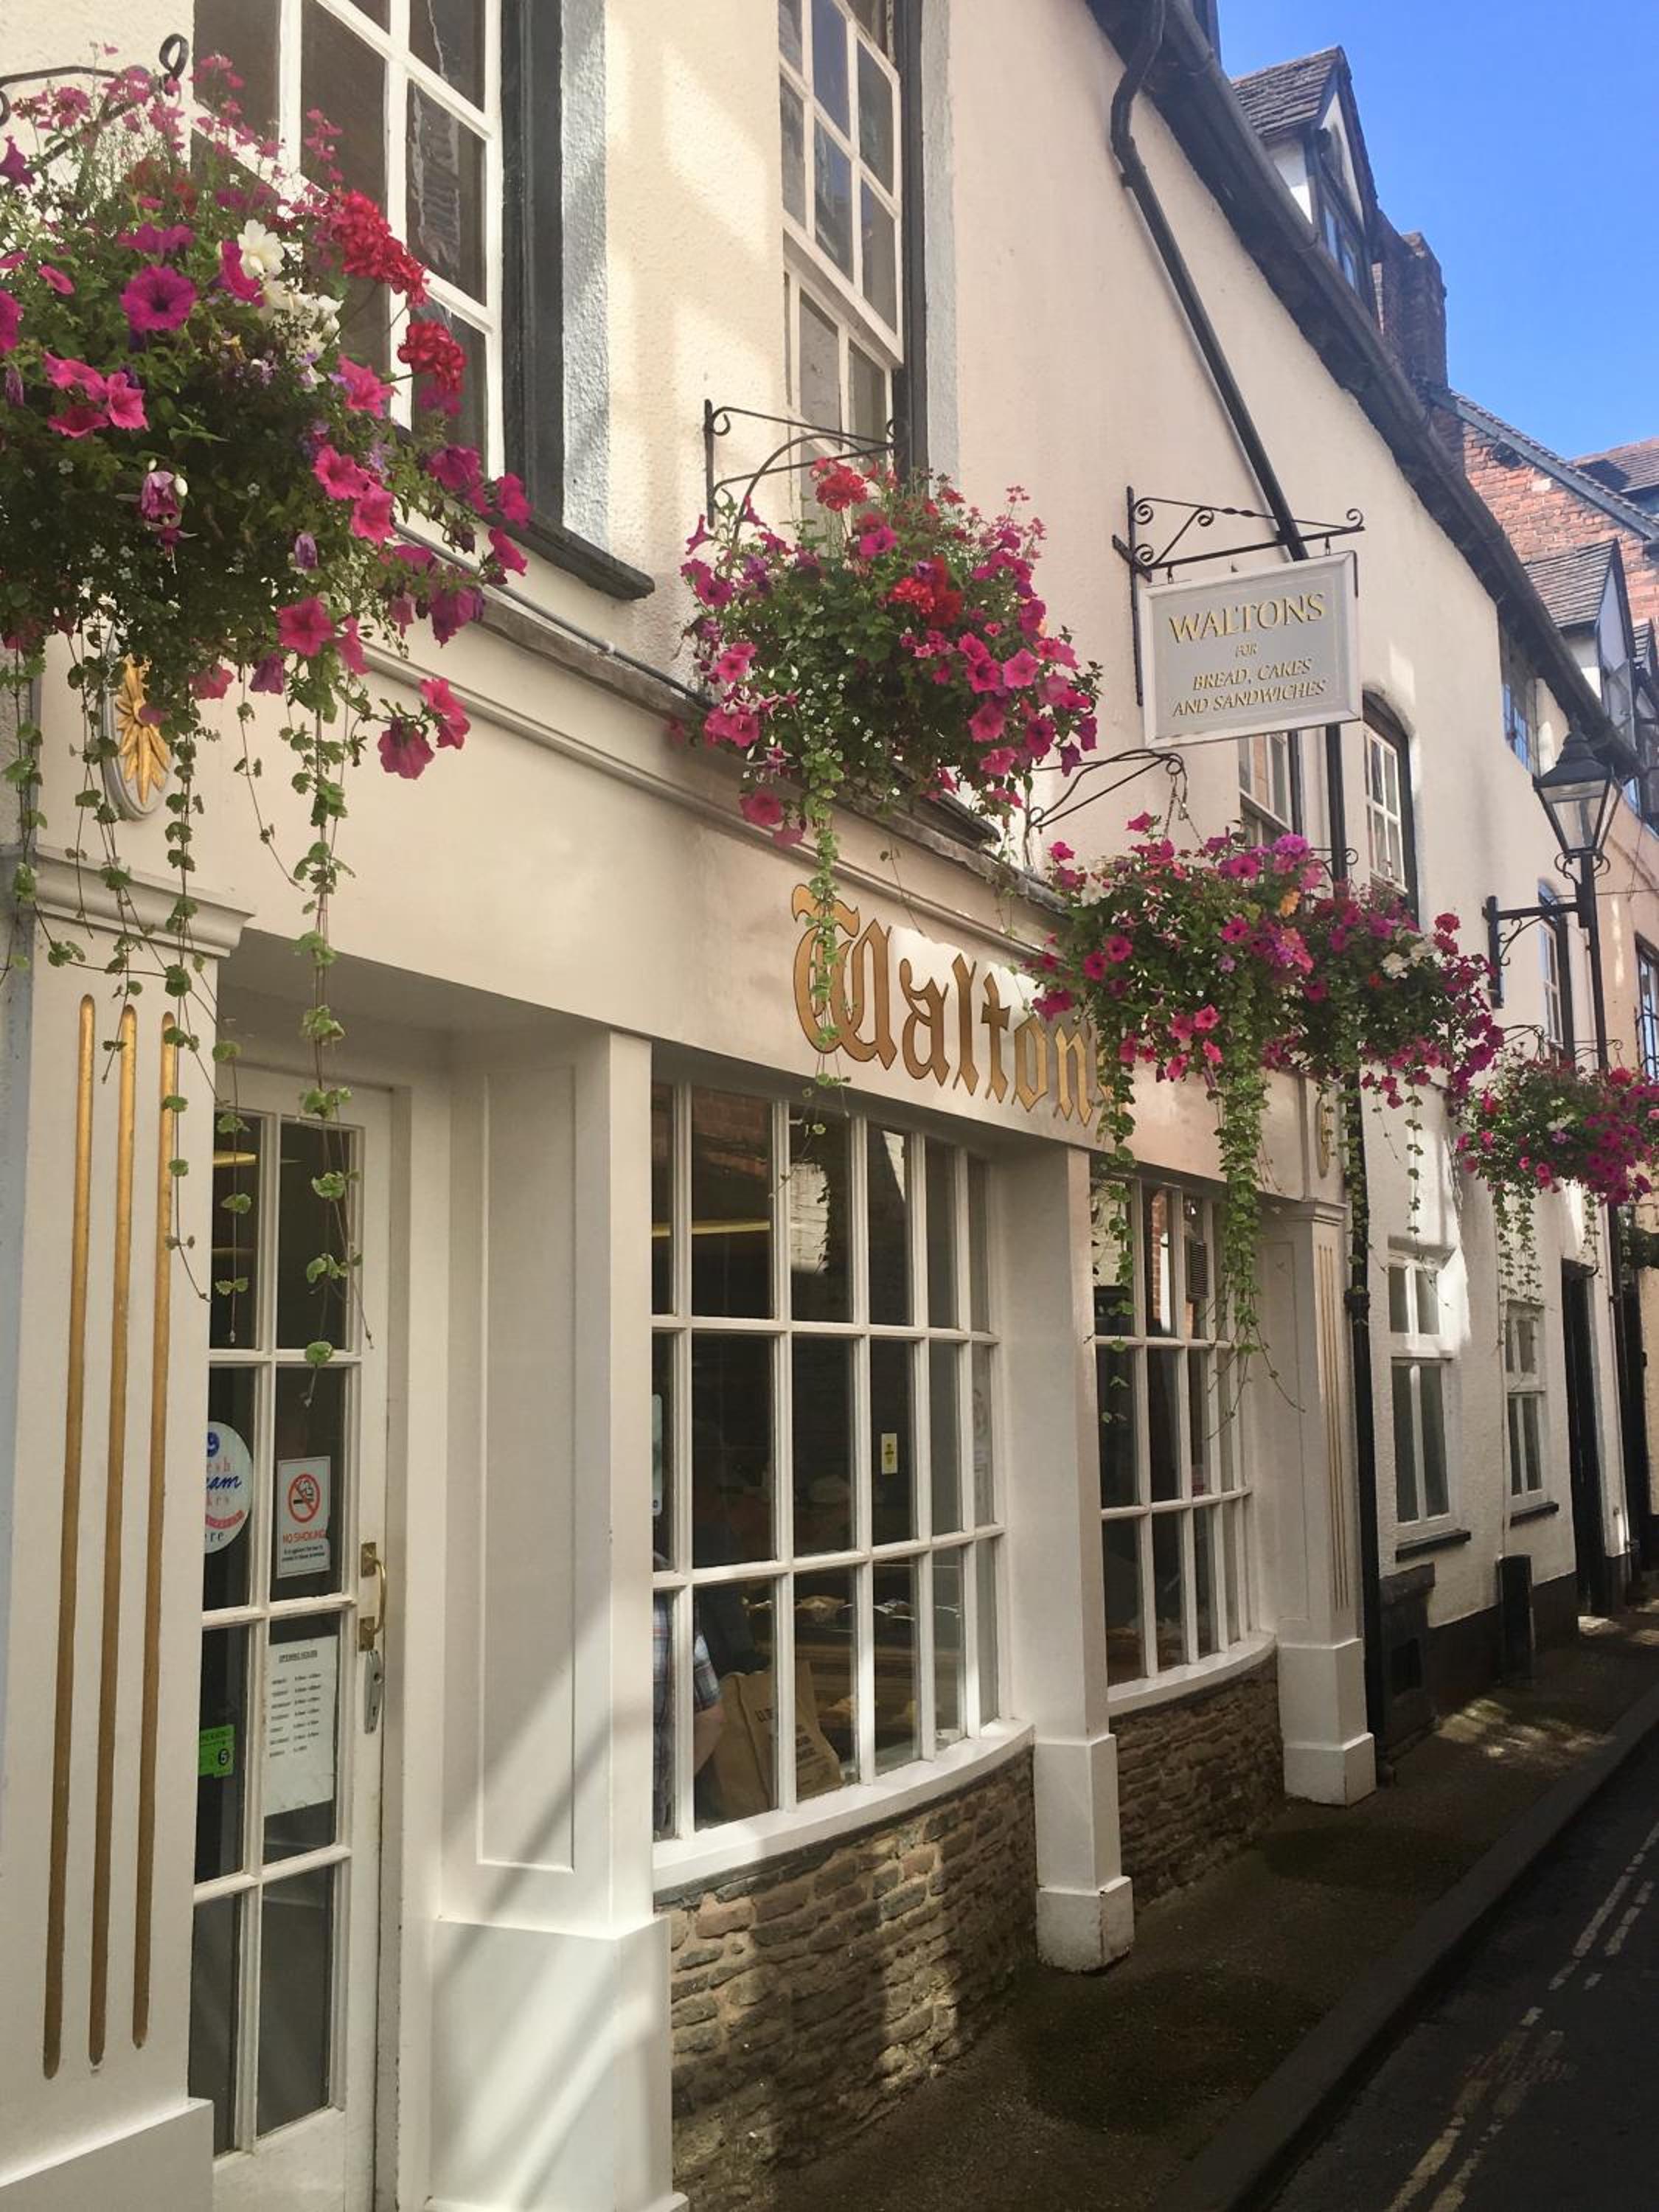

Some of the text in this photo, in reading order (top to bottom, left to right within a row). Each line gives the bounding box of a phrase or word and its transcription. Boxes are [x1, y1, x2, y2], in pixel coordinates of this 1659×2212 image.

[1169, 593, 1326, 644] WALTONS
[1234, 643, 1258, 658] FOR
[1192, 658, 1312, 691] BREAD, CAKES
[1172, 679, 1326, 717] AND SANDWICHES
[791, 883, 1116, 1140] Walton
